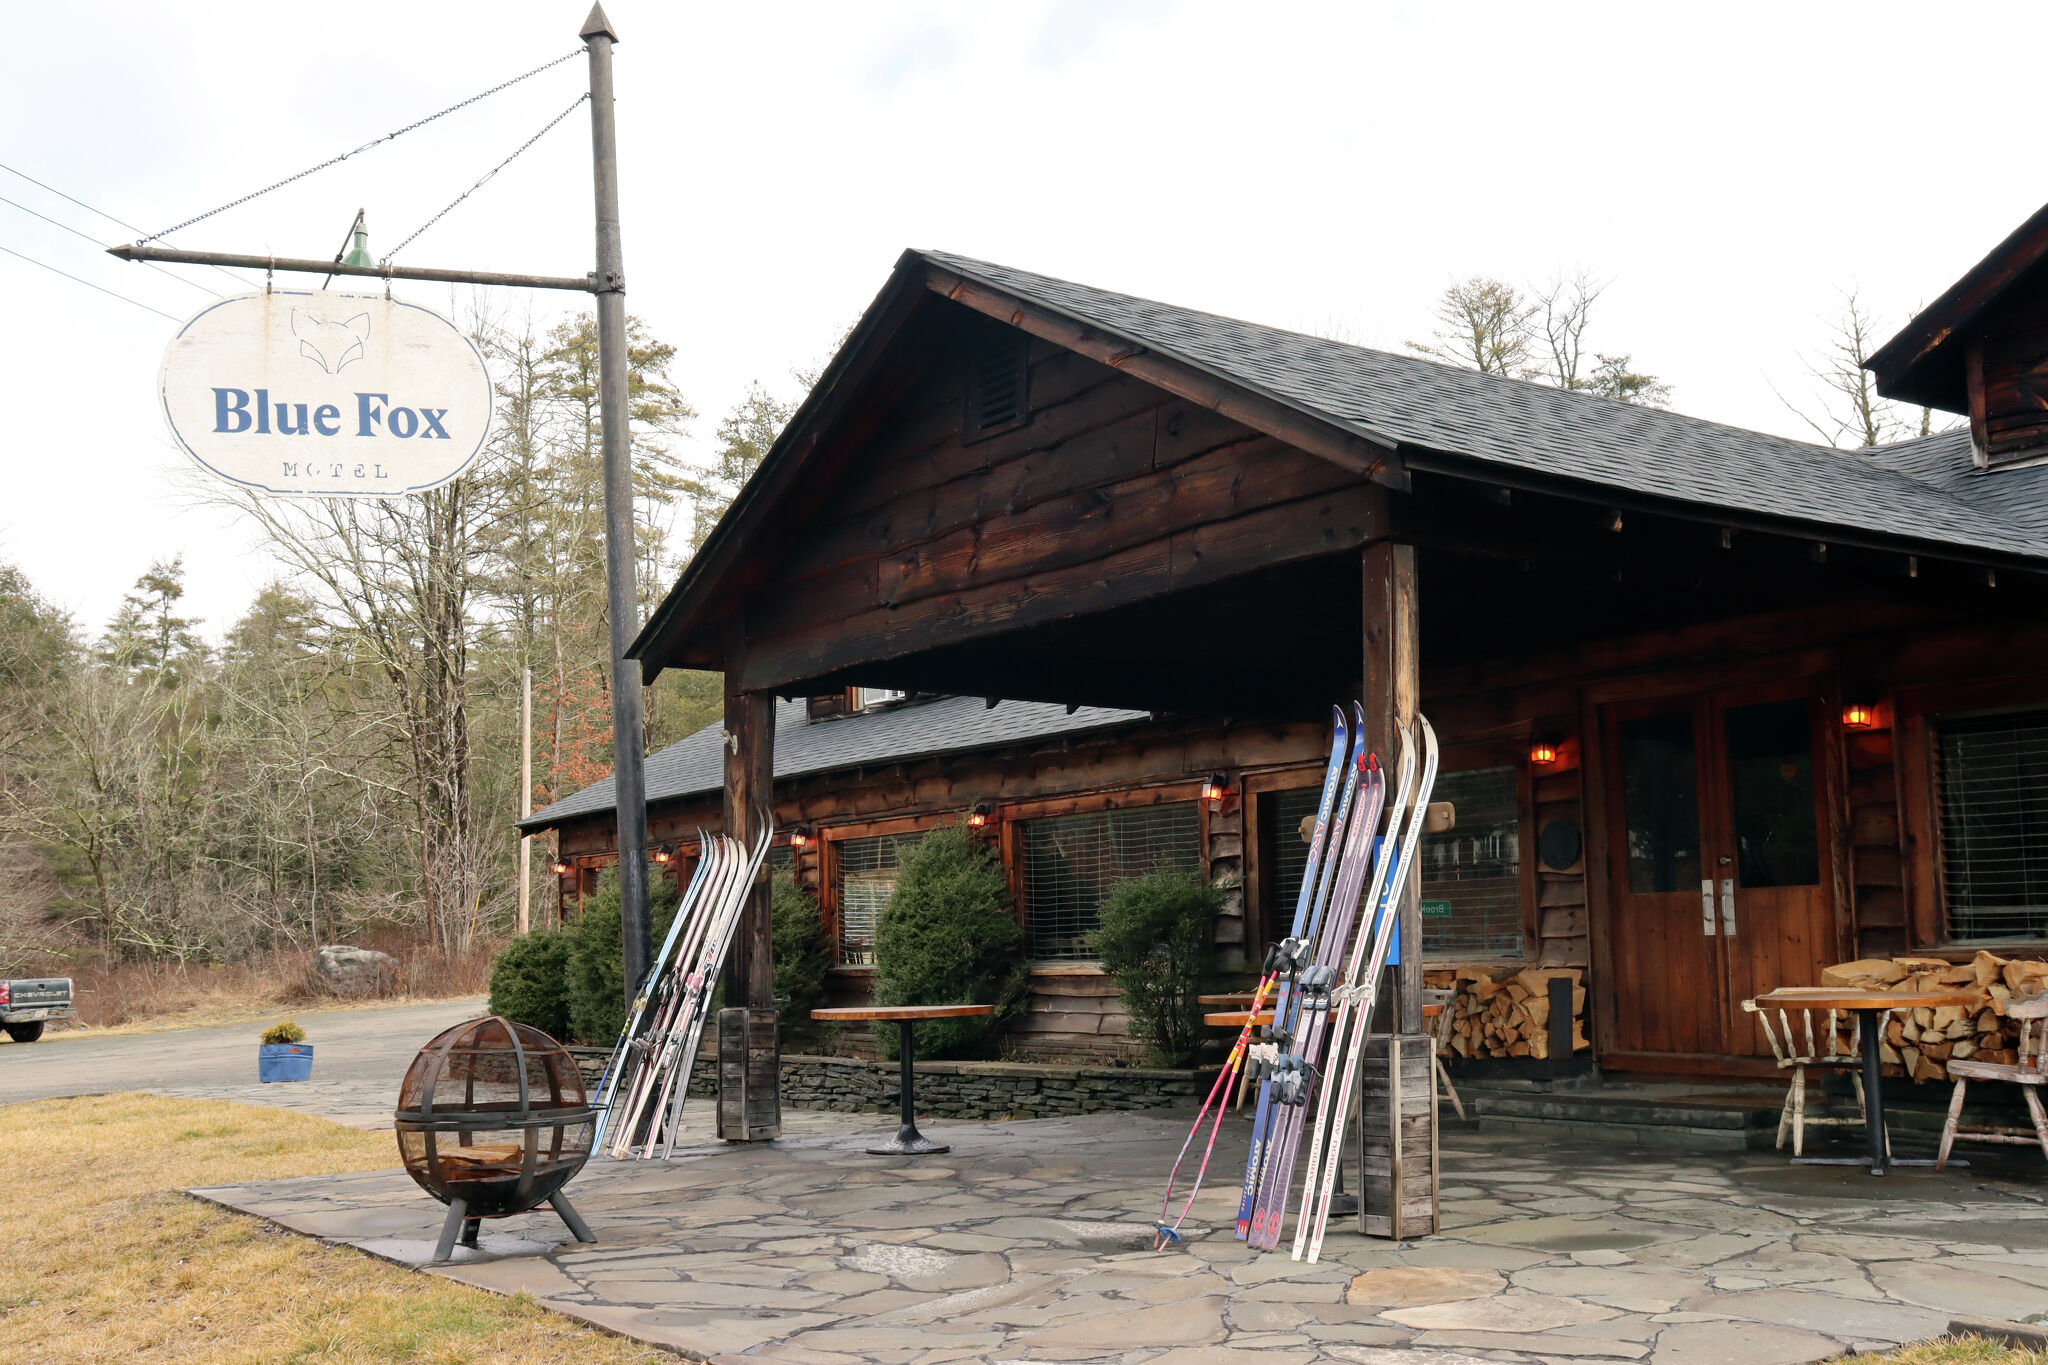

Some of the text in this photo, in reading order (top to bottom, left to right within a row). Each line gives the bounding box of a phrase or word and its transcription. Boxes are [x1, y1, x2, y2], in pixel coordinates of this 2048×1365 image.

[211, 387, 452, 440] Blue Fox
[1321, 766, 1339, 821] ATOMIC
[1327, 763, 1358, 861] ATOMIC ARC
[1308, 820, 1325, 864] ARC
[1247, 1138, 1261, 1197] ATOMIC
